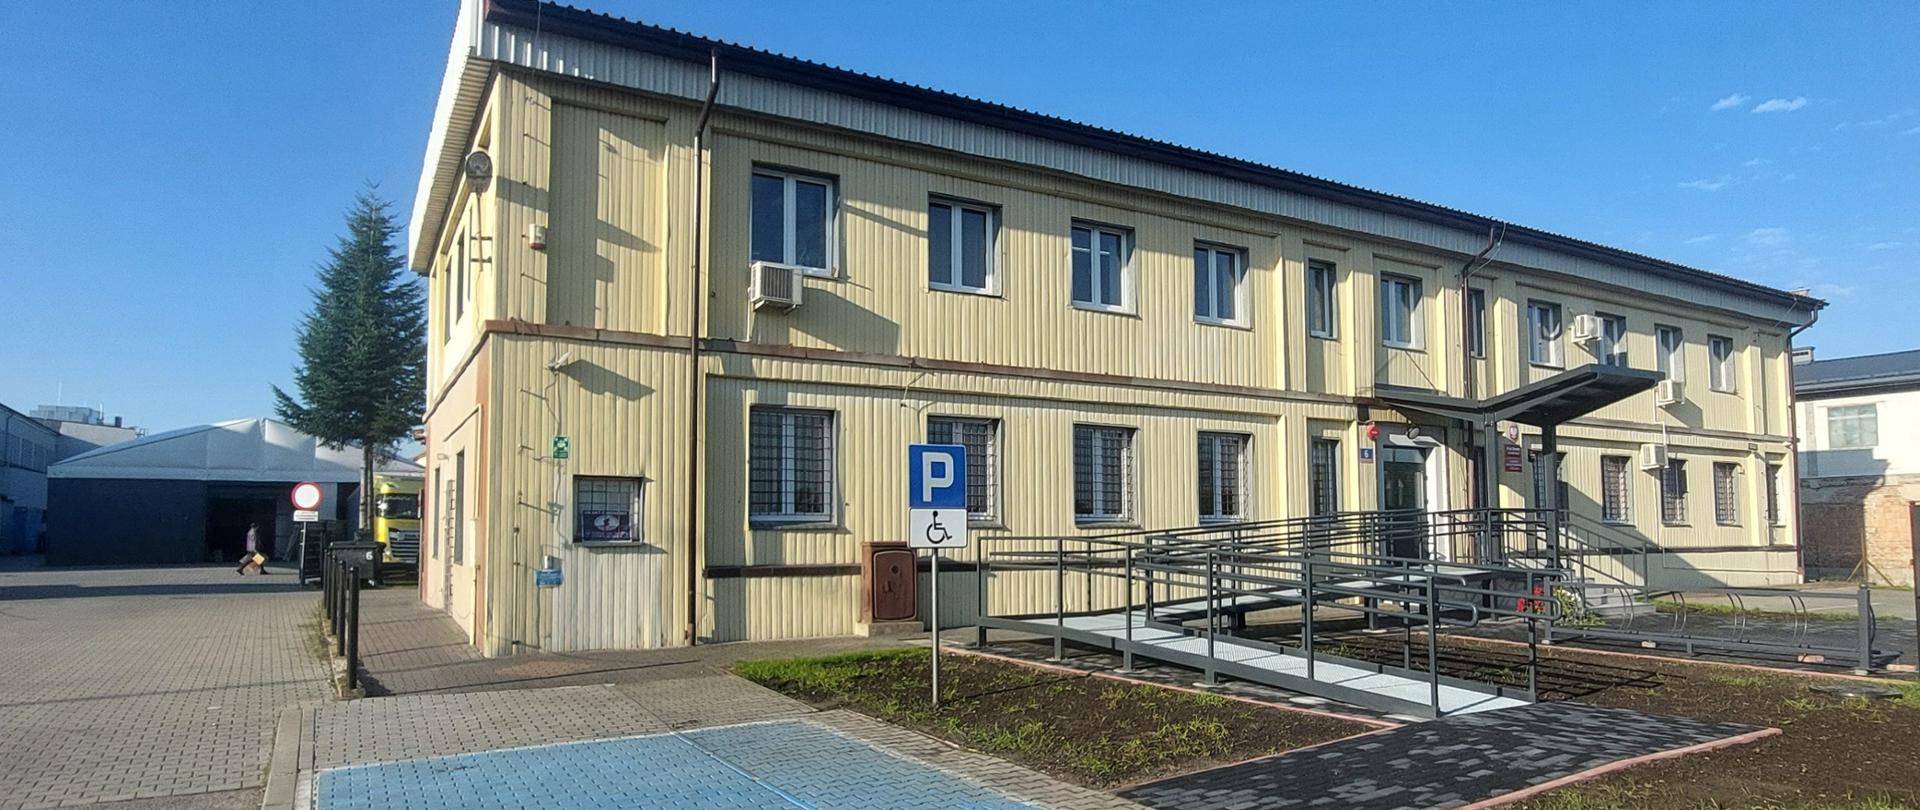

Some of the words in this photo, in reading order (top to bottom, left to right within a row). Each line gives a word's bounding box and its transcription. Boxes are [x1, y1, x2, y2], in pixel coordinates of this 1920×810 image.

[1364, 449, 1370, 458] 6
[922, 451, 954, 502] P
[366, 551, 373, 560] 6
